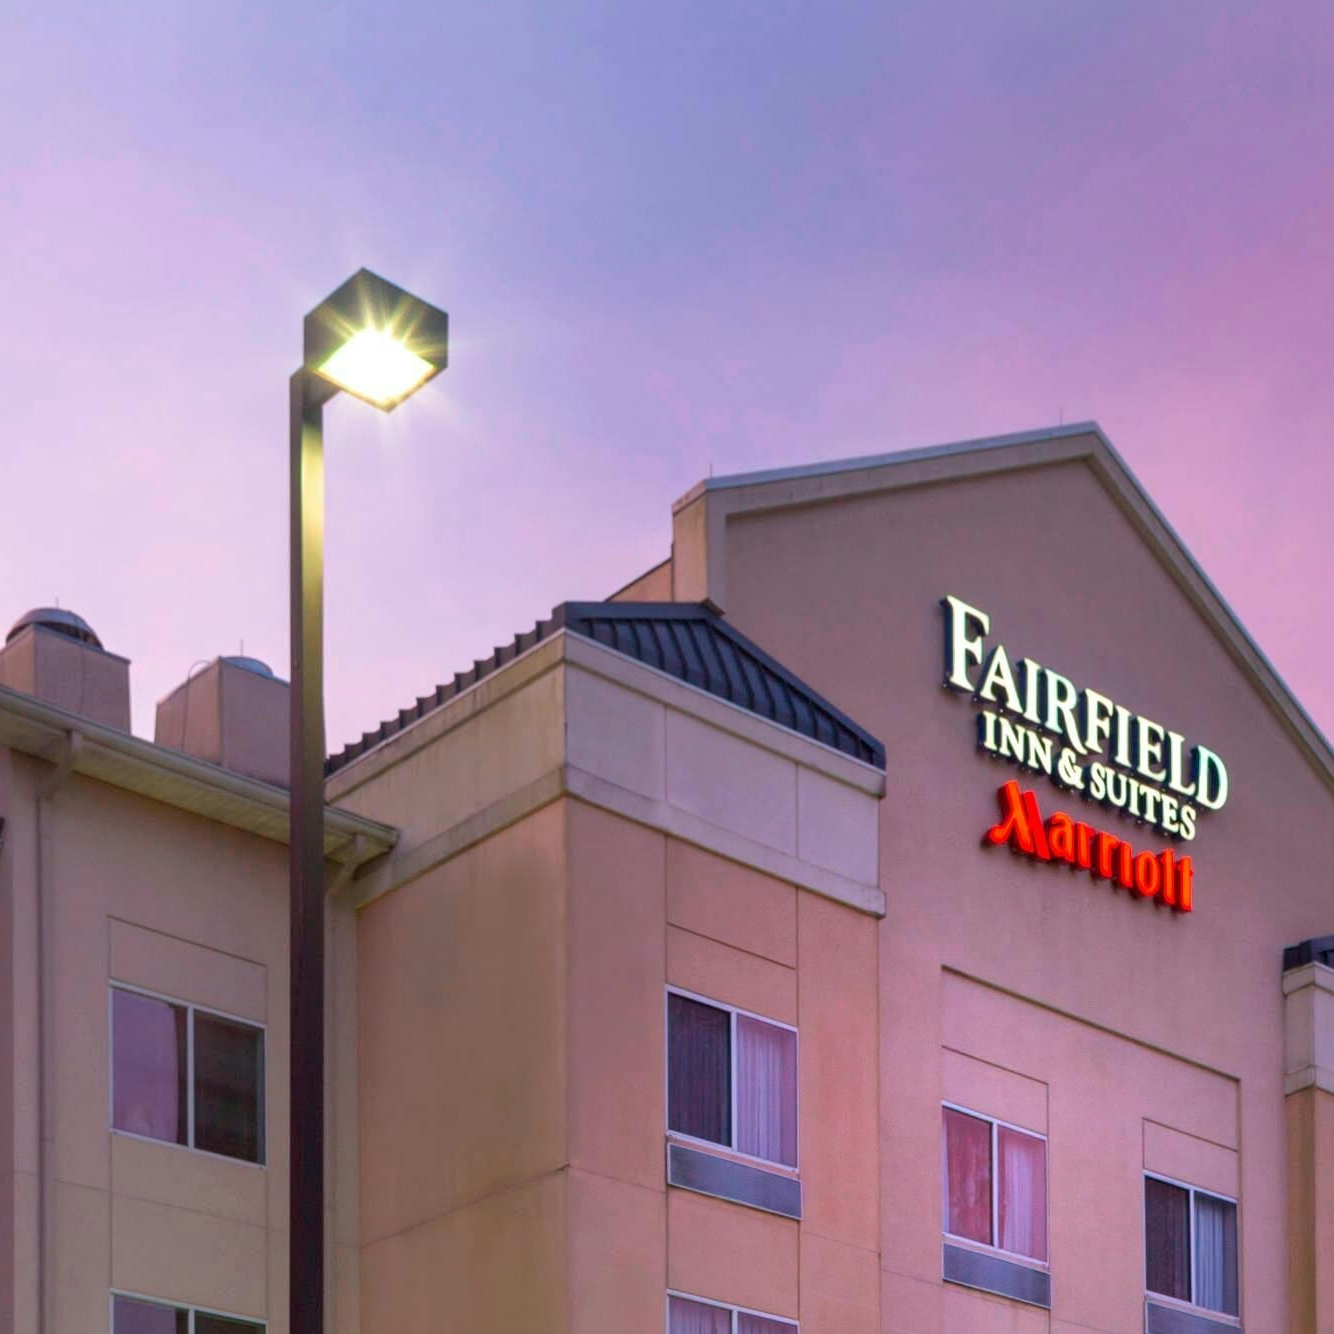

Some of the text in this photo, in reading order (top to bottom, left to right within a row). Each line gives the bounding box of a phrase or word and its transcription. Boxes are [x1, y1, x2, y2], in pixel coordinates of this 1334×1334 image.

[943, 594, 1229, 810] FAIRFIELD
[980, 709, 1197, 842] INN & SUITES
[986, 779, 1195, 913] Marriott
